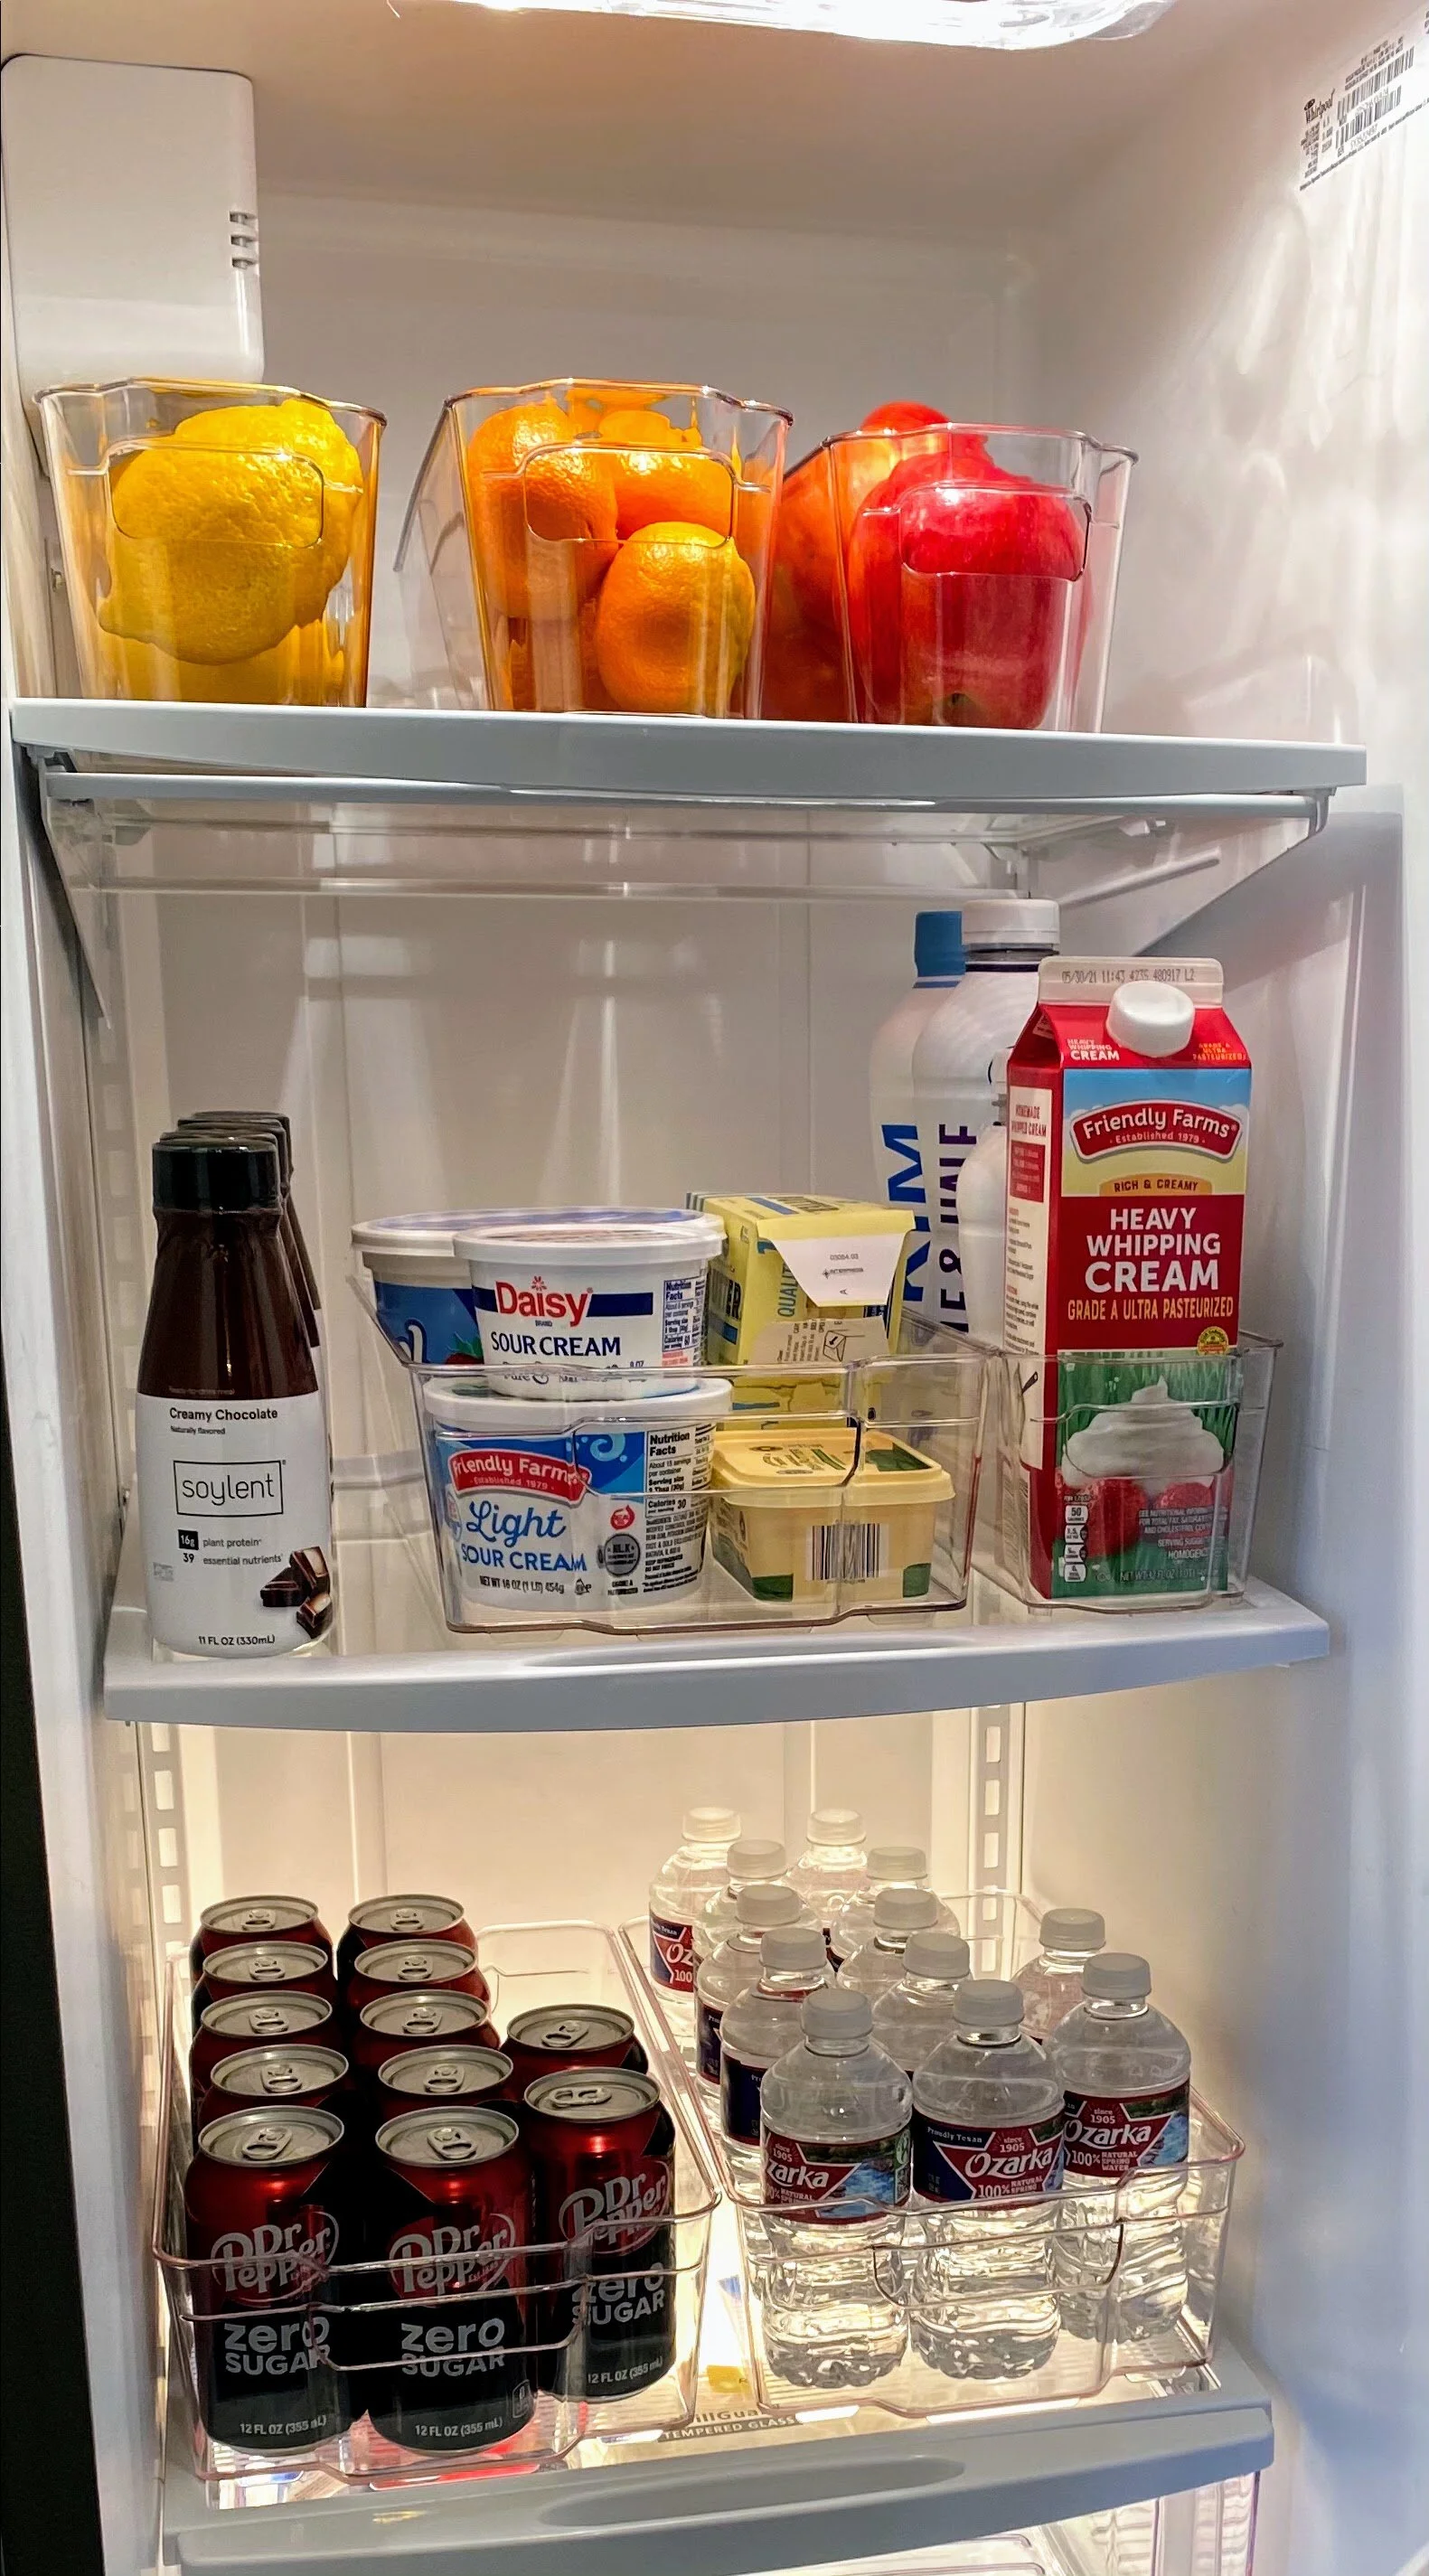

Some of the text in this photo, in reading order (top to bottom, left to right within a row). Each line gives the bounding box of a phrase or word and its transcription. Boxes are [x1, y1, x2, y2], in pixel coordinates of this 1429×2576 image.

[1102, 970, 1125, 982] 11:43
[1184, 969, 1195, 981] L2
[1071, 1050, 1120, 1061] CREAM
[1083, 1107, 1230, 1140] Friendly Farms
[1115, 1133, 1199, 1143] Established 1979
[1114, 1179, 1199, 1192] RICH & CREAMY
[1110, 1208, 1197, 1230] HEAVY
[1086, 1233, 1220, 1256] WHIPPING
[1085, 1260, 1219, 1293] CREAM
[495, 1279, 588, 1327] Daisy
[1067, 1296, 1234, 1320] GRADE A ULTRA PASTEURIZED
[491, 1331, 621, 1357] SOUR CREAM
[169, 1407, 278, 1423] Creamy Chocolate
[650, 1431, 691, 1445] Nutrition
[649, 1445, 676, 1457] Facts
[182, 1473, 275, 1506] soylent
[465, 1500, 568, 1547] Light
[1071, 1507, 1082, 1517] 50
[180, 1535, 195, 1547] 16g
[202, 1537, 225, 1549] plant
[183, 1553, 194, 1564] 39
[202, 1556, 240, 1565] essential
[460, 1542, 504, 1569] SOUR
[509, 1551, 588, 1572] CREAM
[512, 1580, 521, 1590] OZ
[198, 1635, 276, 1646] 11 FL OZ (330mL)
[1090, 2114, 1116, 2124] 1905
[1064, 2120, 1152, 2148] Ozarka
[773, 2148, 794, 2163] 1905
[1000, 2142, 1025, 2153] 1905
[1071, 2149, 1138, 2166] 100% NATURAL
[964, 2147, 1054, 2179] Ozarka
[1101, 2158, 1131, 2166] SPRING
[605, 2173, 647, 2211] Dr
[977, 2176, 1044, 2198] 100% NATURAL
[1011, 2184, 1038, 2195] SPRING
[559, 2175, 668, 2246] Pepper
[251, 2223, 302, 2260] Dr
[432, 2224, 481, 2259] Dr
[211, 2226, 333, 2295] Pepper
[389, 2226, 509, 2296] Pepper
[572, 2262, 664, 2304] zero
[572, 2289, 665, 2327] SUGAR
[224, 2316, 330, 2354] zero
[400, 2317, 506, 2354] zero
[225, 2345, 331, 2376] SUGAR
[400, 2346, 506, 2378] SUGAR
[588, 2372, 600, 2384] 12
[600, 2371, 614, 2383] FL
[615, 2369, 629, 2382] OZ
[239, 2422, 253, 2435] 12
[254, 2424, 268, 2436] FL
[268, 2424, 284, 2436] OZ
[285, 2420, 309, 2436] (355
[415, 2417, 503, 2438] 12 FL OZ (355 mL)
[663, 2416, 795, 2440] TEMPERED GLASS
